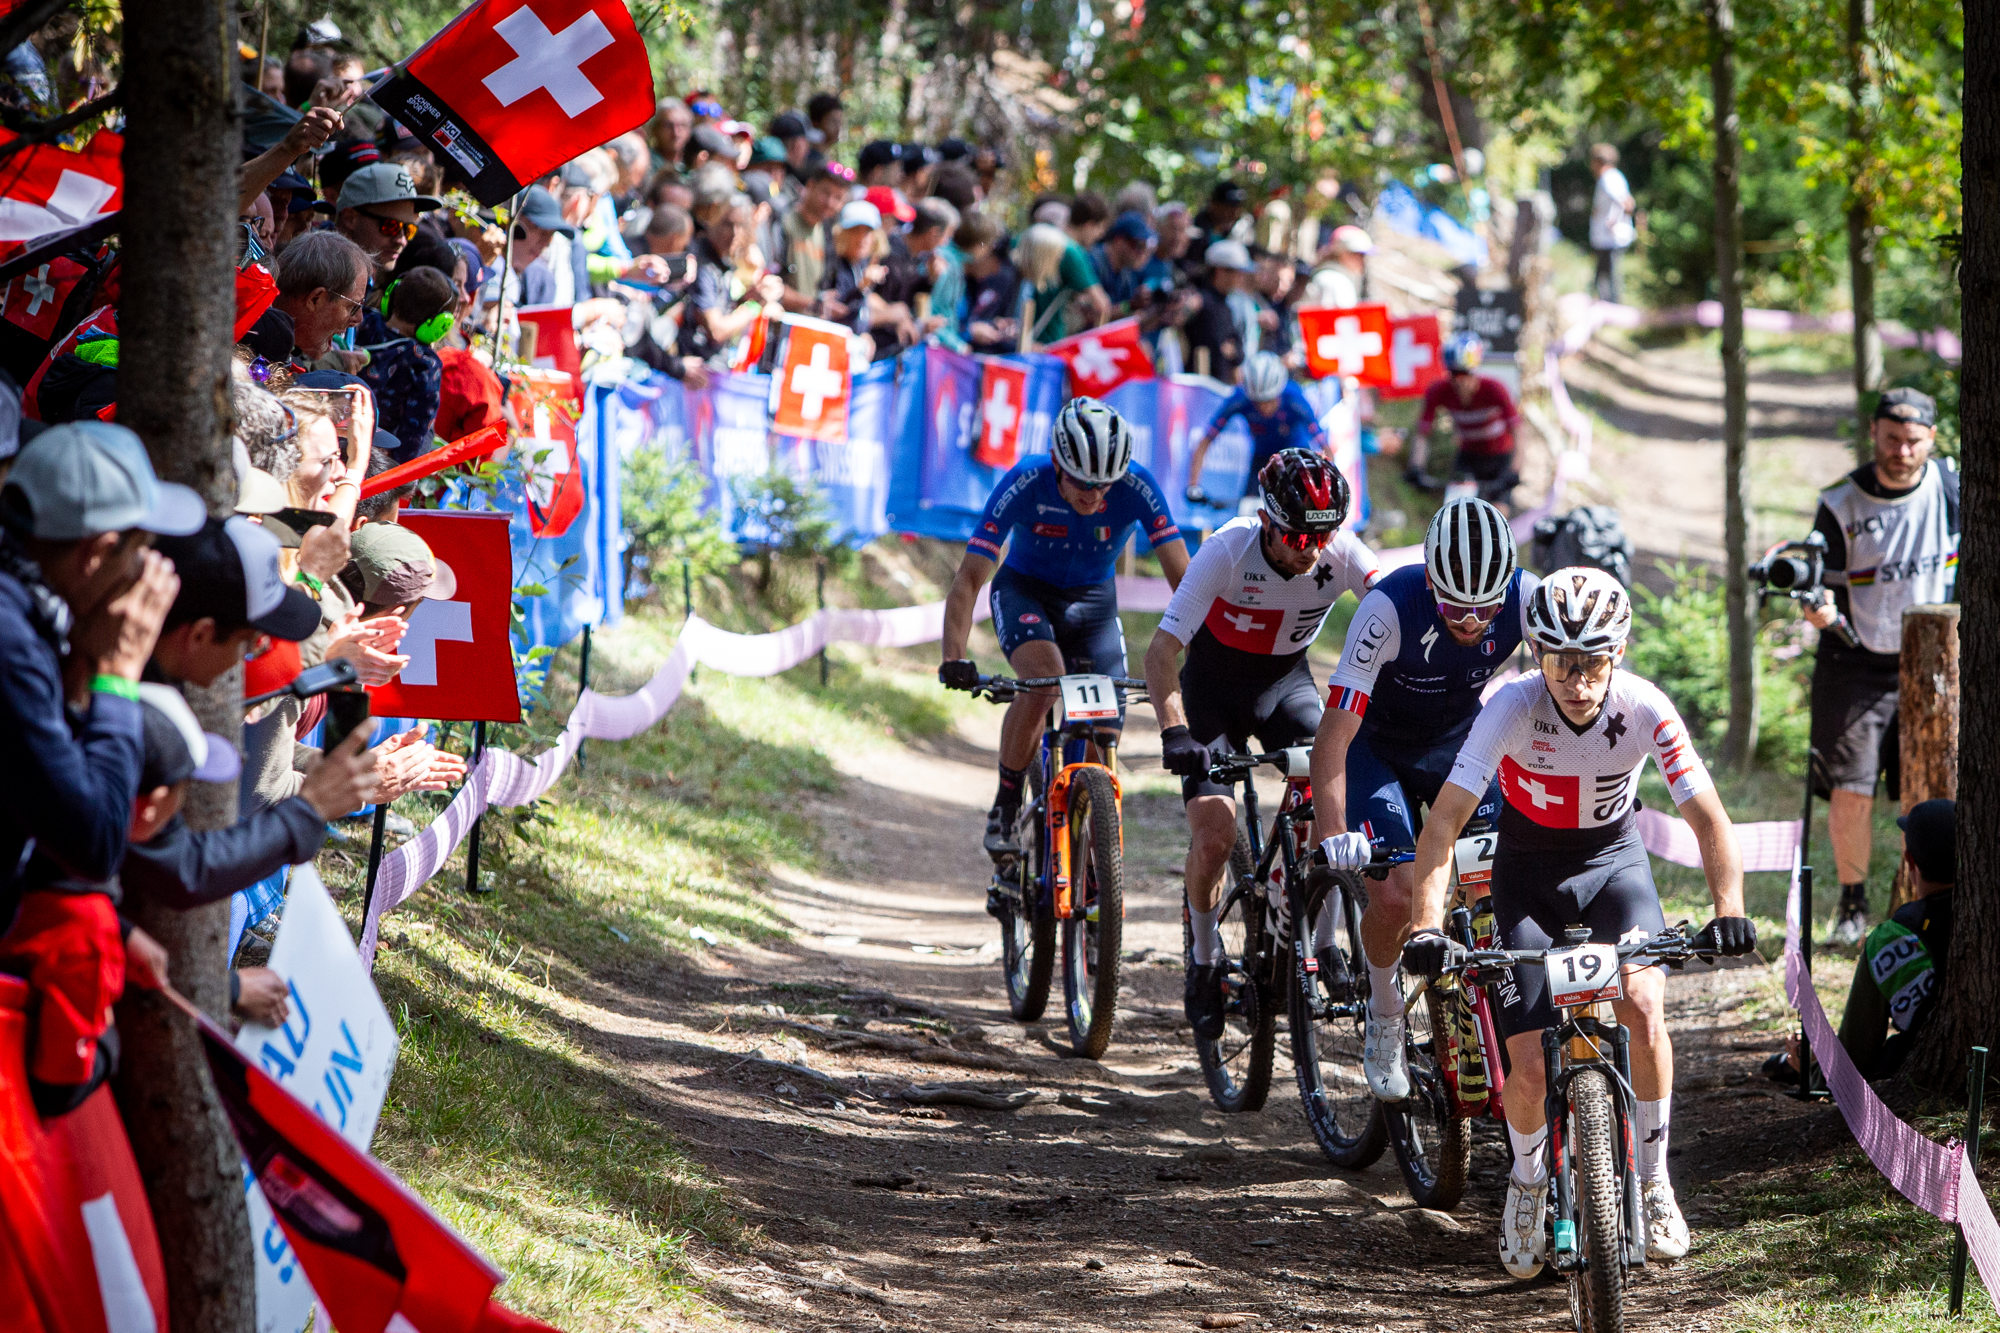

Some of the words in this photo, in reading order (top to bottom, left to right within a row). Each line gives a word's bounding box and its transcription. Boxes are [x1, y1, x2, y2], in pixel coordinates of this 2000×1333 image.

[407, 96, 427, 116] SPORT
[414, 93, 441, 119] OCHSNER
[444, 123, 459, 139] UCI
[1266, 492, 1290, 522] GIRO
[1881, 553, 1940, 583] STAFF
[1356, 622, 1386, 665] CIC
[1077, 684, 1100, 704] 11
[1534, 719, 1559, 735] ÖKK
[1562, 954, 1602, 983] 19
